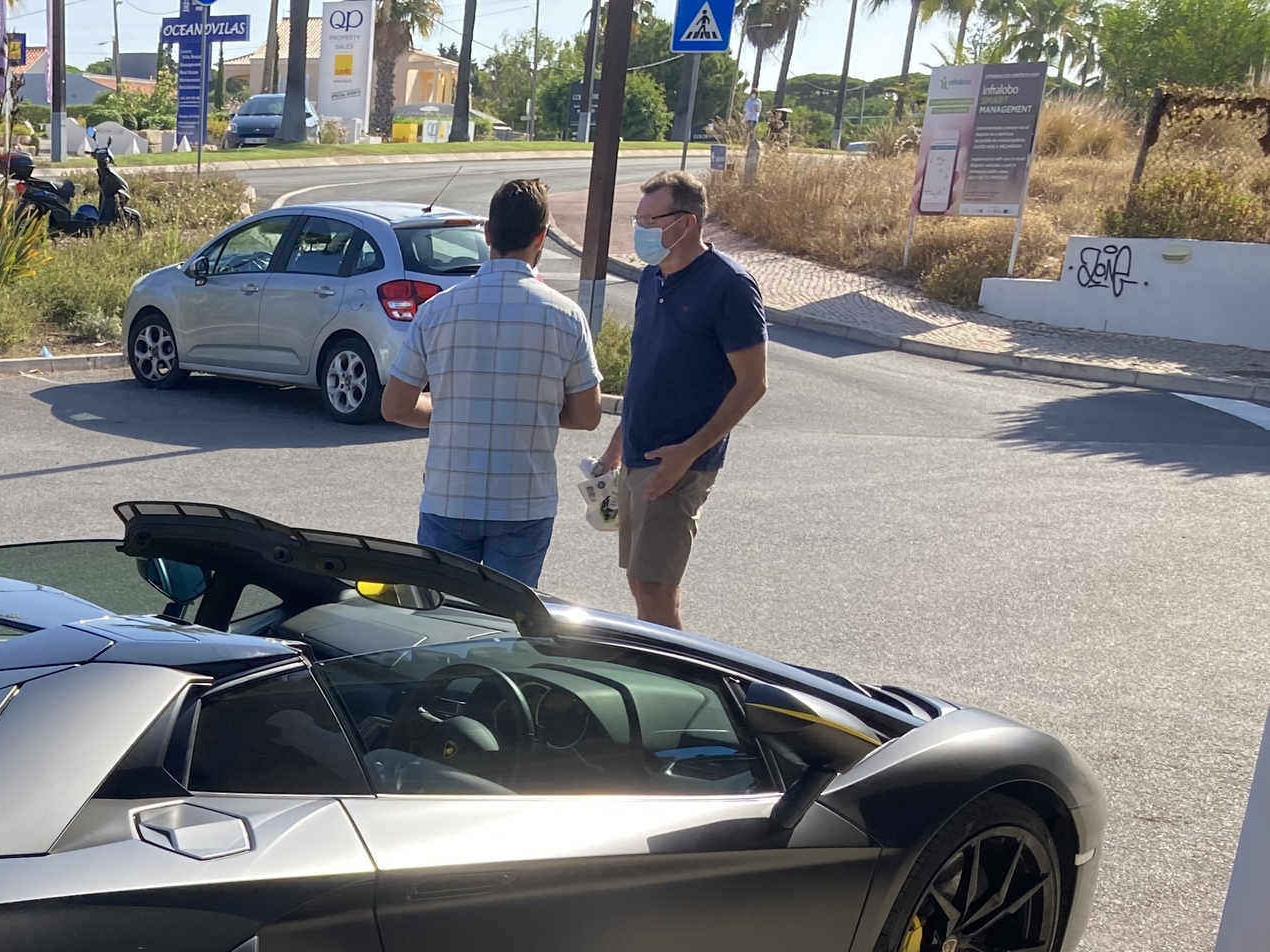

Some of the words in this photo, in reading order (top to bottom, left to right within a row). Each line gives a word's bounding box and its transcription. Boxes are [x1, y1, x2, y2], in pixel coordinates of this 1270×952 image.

[982, 84, 1019, 95] infralobo
[981, 96, 1009, 105] SMART
[979, 105, 1033, 114] MANAGEMENT
